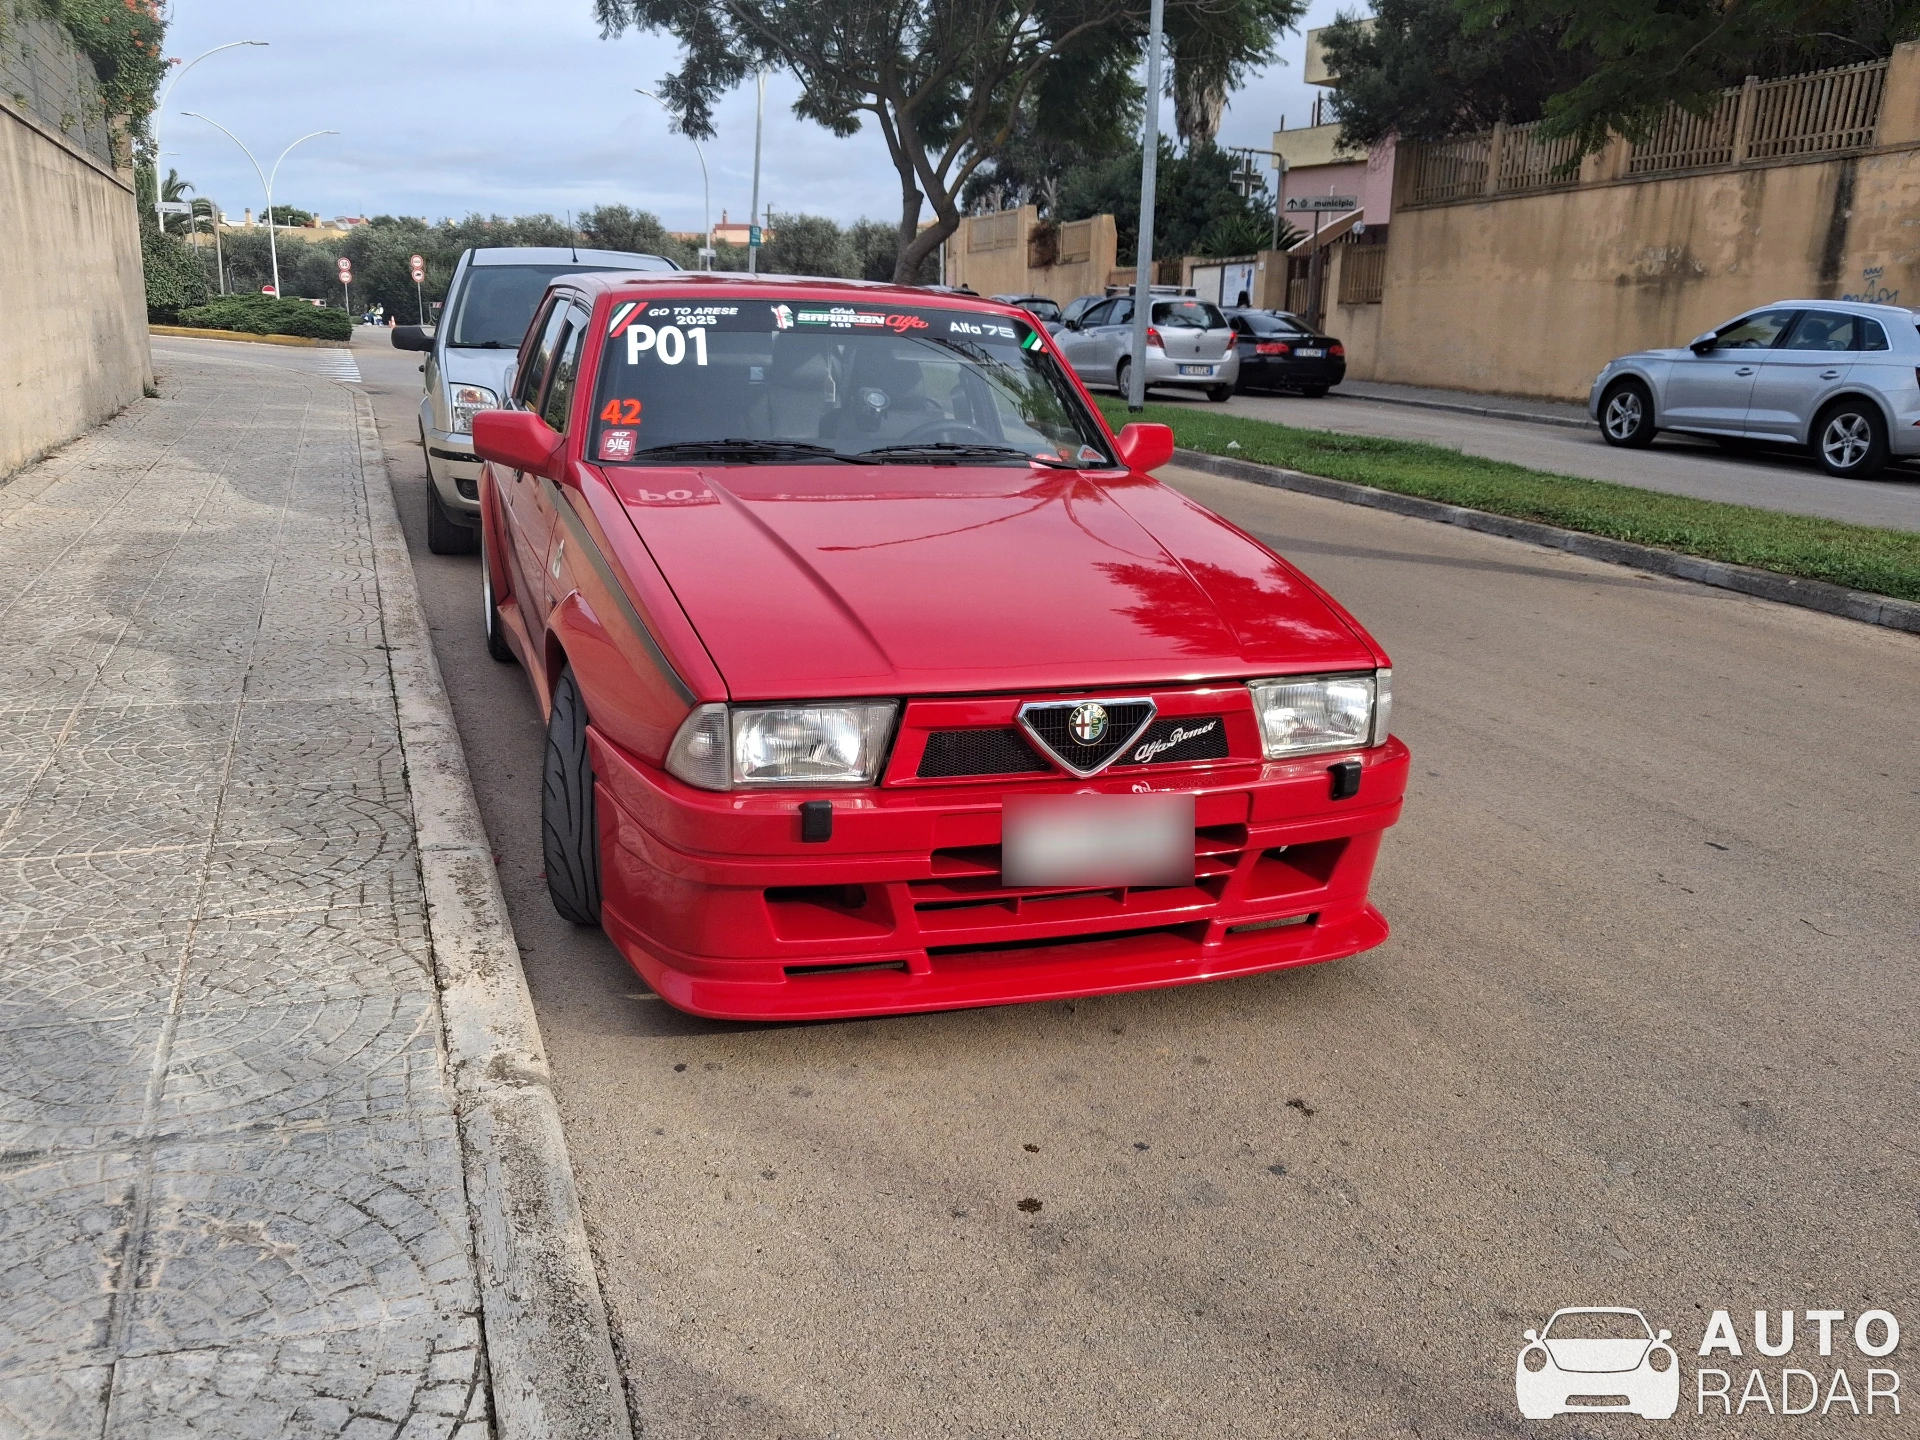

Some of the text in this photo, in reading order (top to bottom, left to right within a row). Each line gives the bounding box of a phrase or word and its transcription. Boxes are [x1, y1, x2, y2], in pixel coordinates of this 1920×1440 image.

[1314, 199, 1354, 208] municipio
[648, 306, 739, 317] GO TO ARESE
[675, 315, 717, 325] 2025
[950, 321, 1016, 339] Alfa 75
[627, 324, 708, 366] P01
[600, 398, 642, 425] 42
[606, 438, 631, 447] Alfa
[1134, 720, 1217, 763] Alfa Romeo
